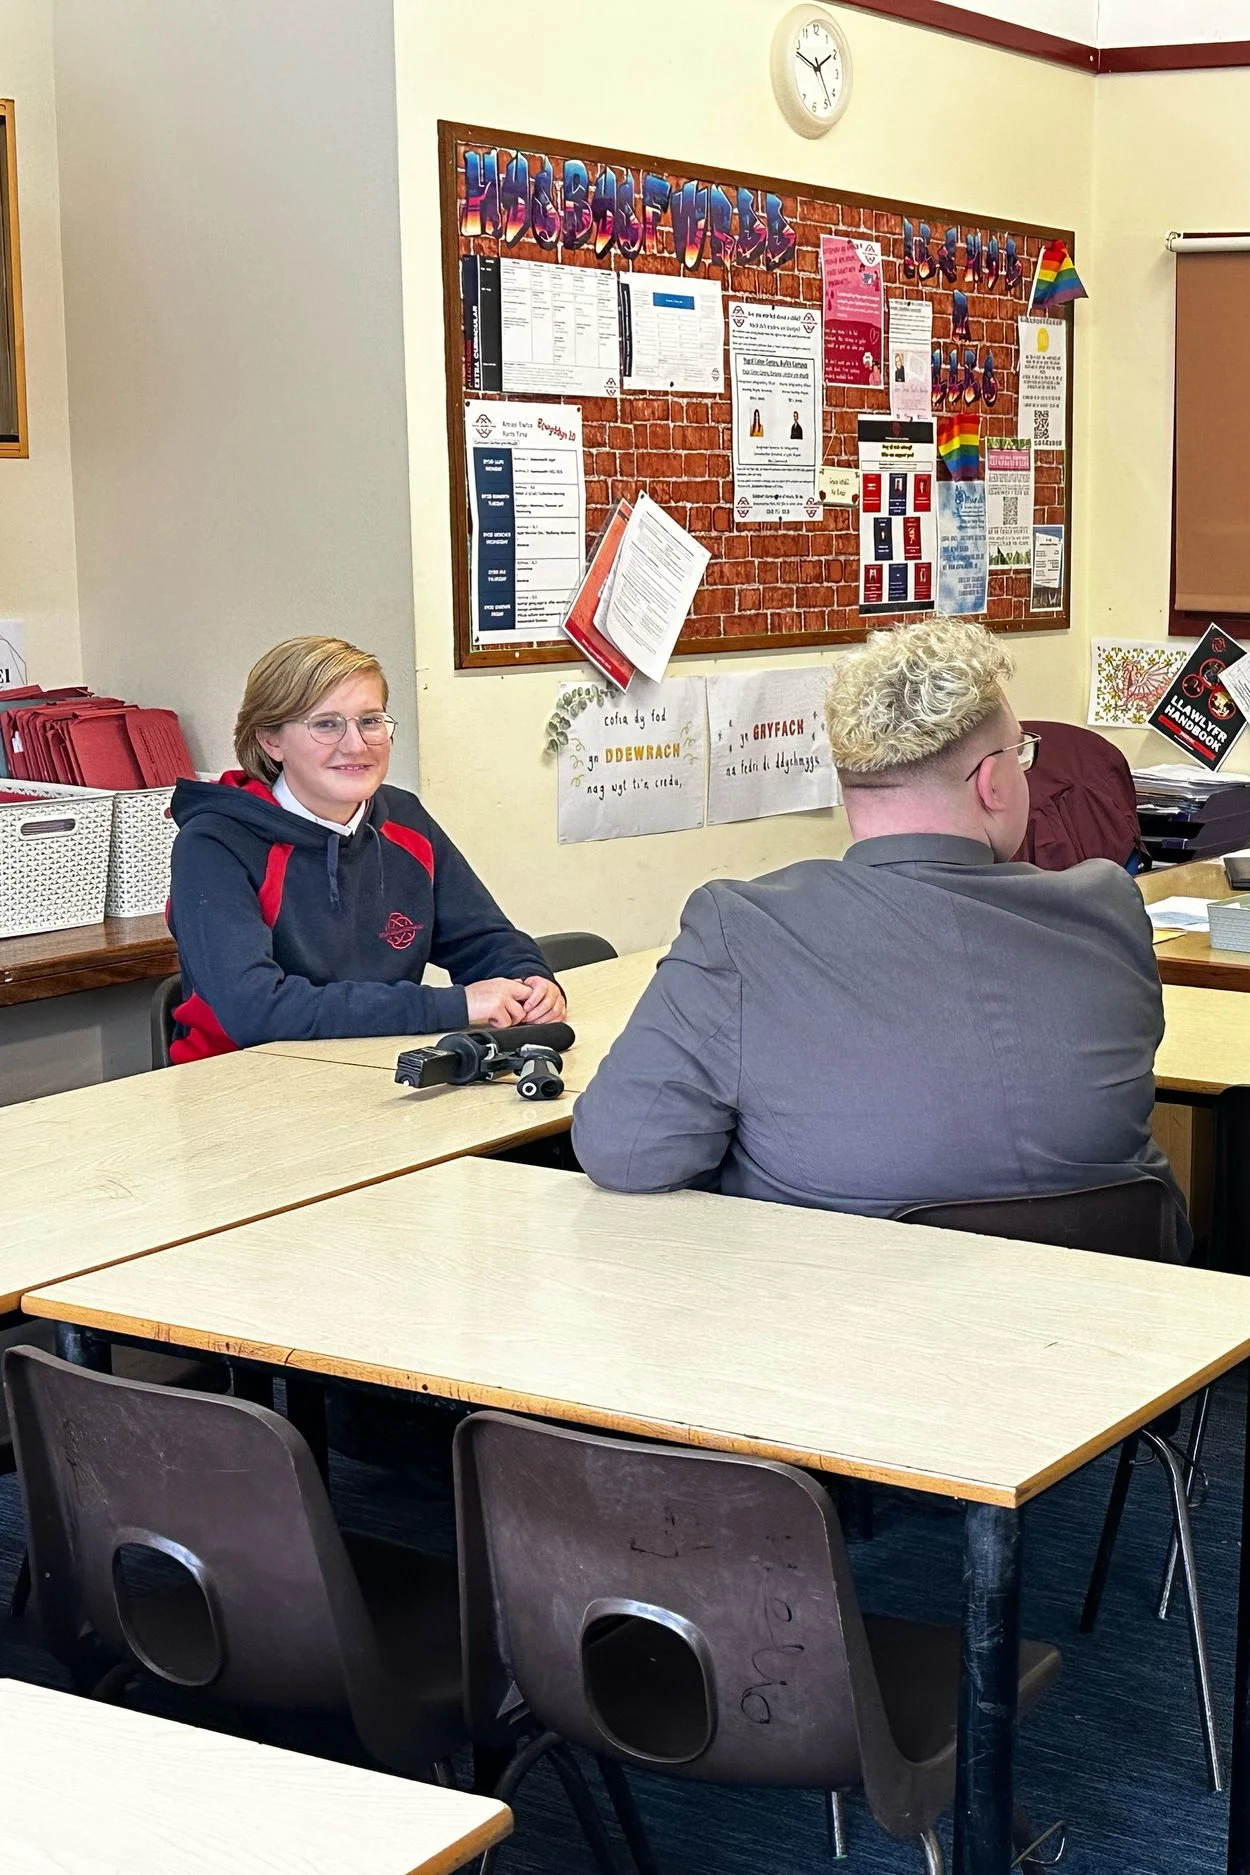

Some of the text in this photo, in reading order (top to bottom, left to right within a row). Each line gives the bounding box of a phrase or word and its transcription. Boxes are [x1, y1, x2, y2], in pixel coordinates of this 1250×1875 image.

[604, 707, 667, 730] cofia dy fod
[753, 718, 804, 740] GRYFACH
[1164, 705, 1222, 753] HANDBOOK
[1170, 695, 1228, 743] LLAWLYFR
[587, 743, 681, 772] yn DDEWRACH
[726, 766, 737, 776] na
[763, 755, 770, 771] di
[587, 785, 605, 801] nag
[611, 779, 627, 797] wyt
